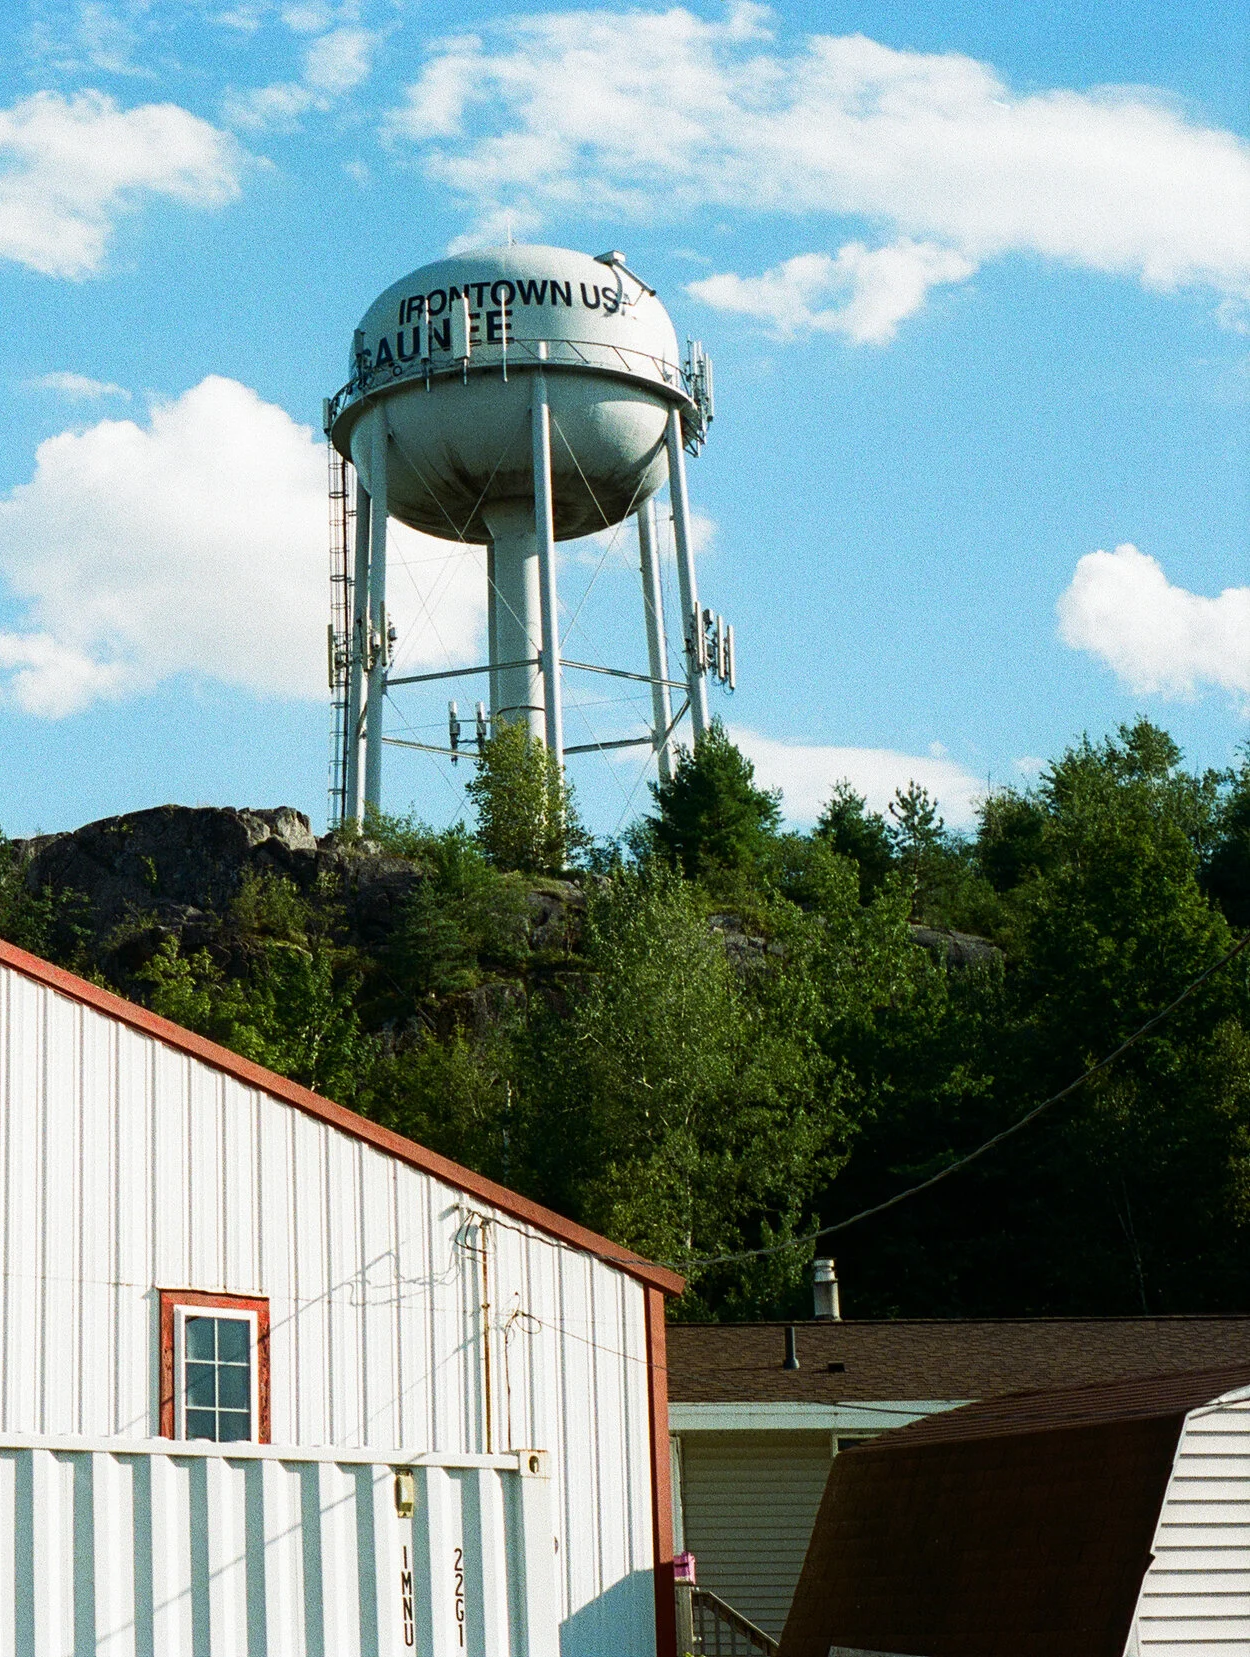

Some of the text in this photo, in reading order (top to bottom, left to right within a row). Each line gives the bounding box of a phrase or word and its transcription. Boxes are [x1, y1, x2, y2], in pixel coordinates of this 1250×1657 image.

[399, 279, 572, 325] IRONTOWN
[400, 1545, 414, 1647] IMNU
[453, 1548, 465, 1648] 22G1
